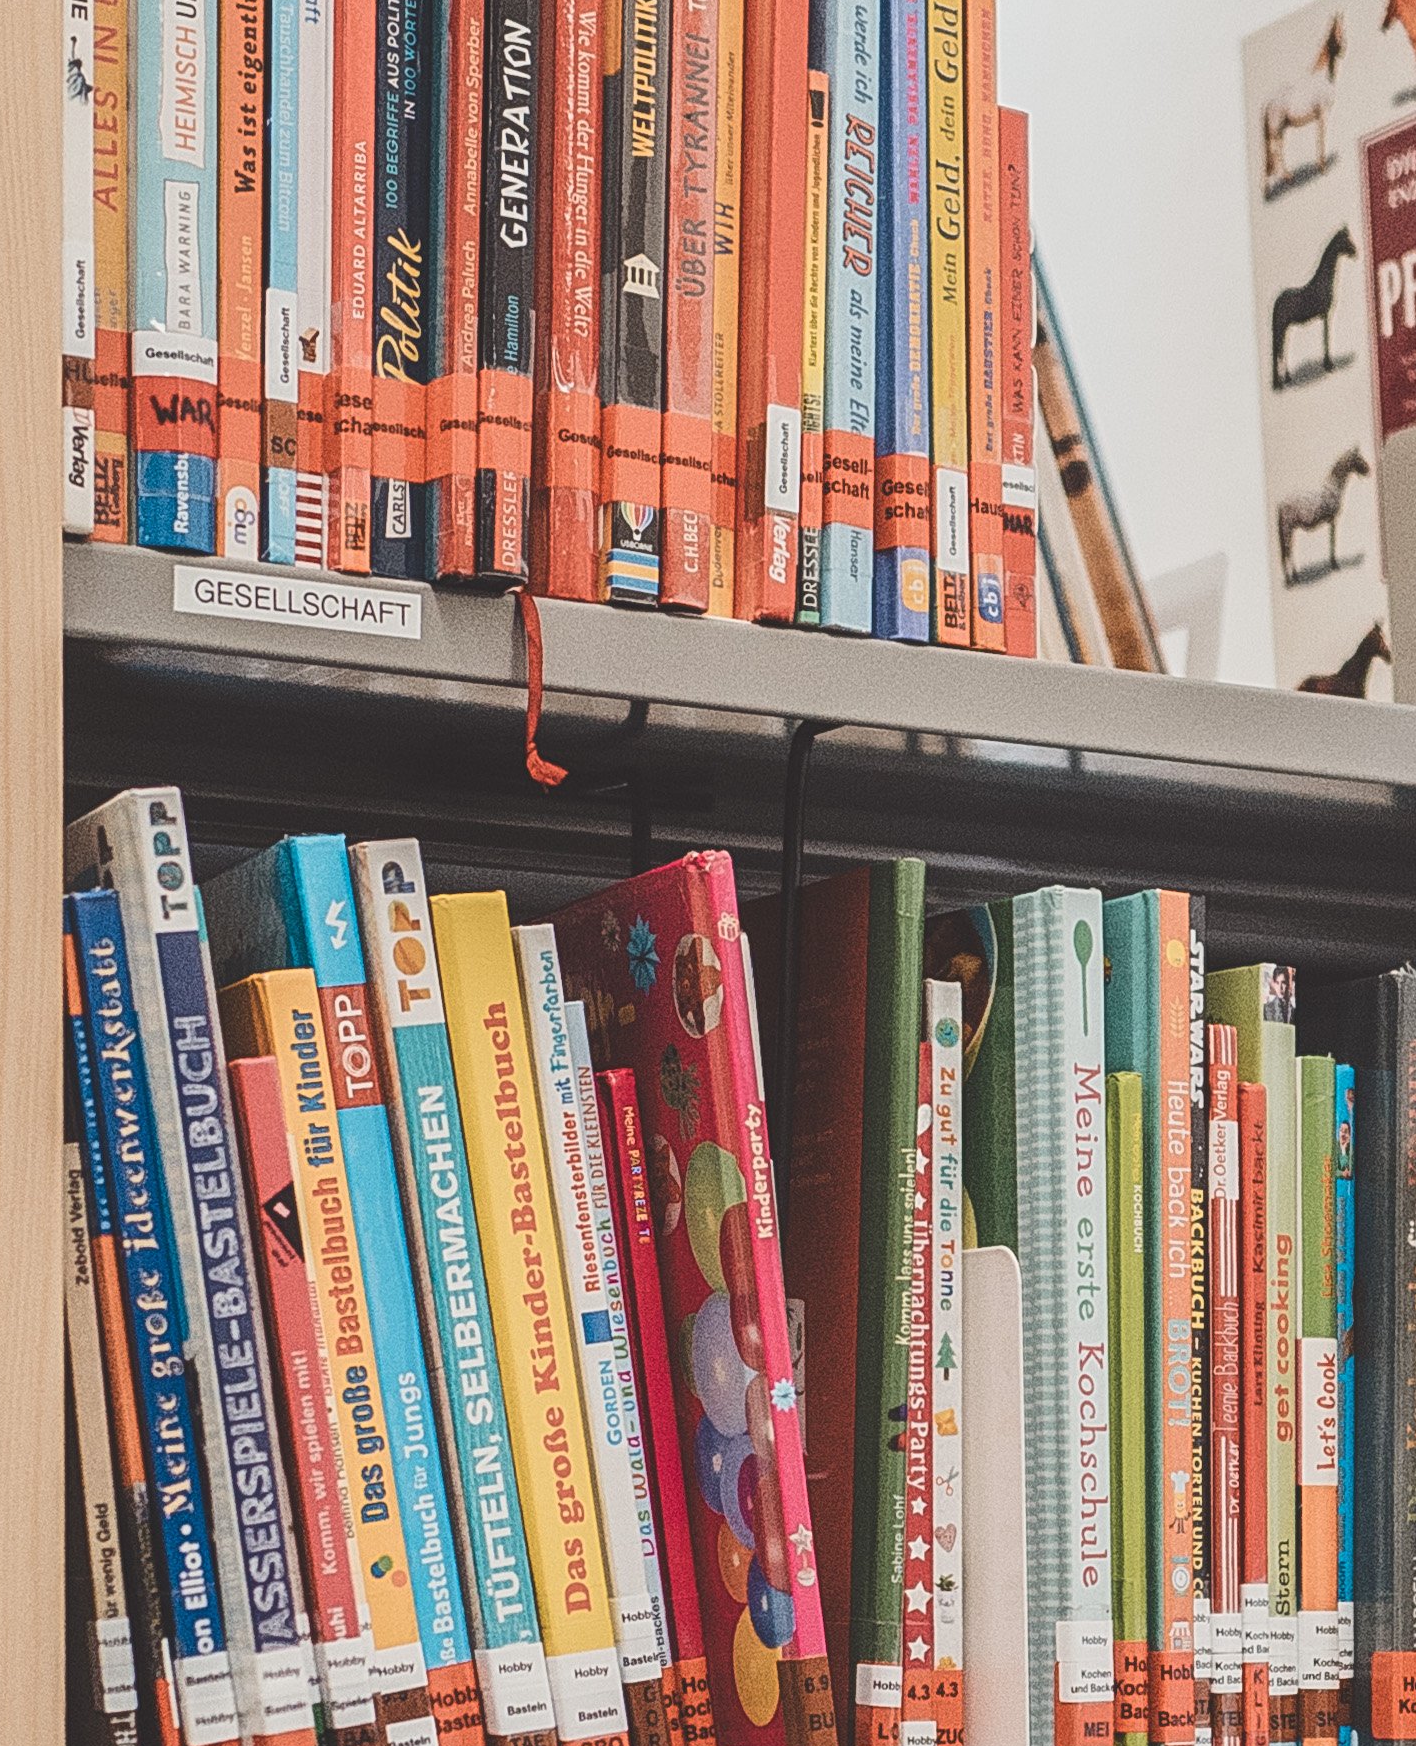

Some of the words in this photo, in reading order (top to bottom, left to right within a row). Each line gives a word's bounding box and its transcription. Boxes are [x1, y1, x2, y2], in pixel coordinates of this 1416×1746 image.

[854, 4, 868, 68] werde
[934, 1, 958, 84] Geld
[174, 27, 198, 152] HEIMISCH
[684, 31, 708, 193] TYRANNEI
[936, 96, 955, 142] dein
[93, 90, 118, 210] ALLES
[235, 146, 257, 195] Was
[387, 92, 400, 172] BEGRIFFE
[499, 19, 531, 248] GENERATION
[353, 140, 367, 241] ALTARRIBA
[571, 146, 594, 215] Hunger
[352, 246, 366, 319] EDUARD
[675, 216, 706, 297] ÜBER
[943, 253, 958, 306] Mein
[376, 228, 422, 384] Politik
[574, 287, 593, 337] Welt?
[194, 581, 411, 628] GESELLSCHAFT
[148, 800, 188, 921] TOPP
[380, 860, 432, 1014] TOPP
[290, 1010, 327, 1111] Kinder
[336, 992, 374, 1099] TOPP
[1073, 1063, 1102, 1198] Meine
[1167, 1080, 1185, 1156] Heute
[744, 1102, 775, 1240] Kinderparty
[1167, 1166, 1185, 1235] back
[309, 1176, 365, 1356] Bastelbuch
[939, 1239, 958, 1312] Tonne
[1075, 1217, 1096, 1322] erste
[1191, 1189, 1205, 1330] BACKBUCH
[341, 1365, 386, 1457] große
[401, 1372, 430, 1459] Jungs
[601, 1359, 624, 1446] GORDEN
[1315, 1353, 1336, 1409] Cook
[359, 1463, 389, 1525] Das
[419, 1492, 455, 1634] Bastelbuch
[564, 1543, 592, 1614] Das
[1275, 1540, 1291, 1616] Stern
[498, 1660, 533, 1675] Hobby
[574, 1665, 609, 1679] Hobby
[506, 1701, 547, 1716] Basteln
[578, 1707, 618, 1722] Basteln
